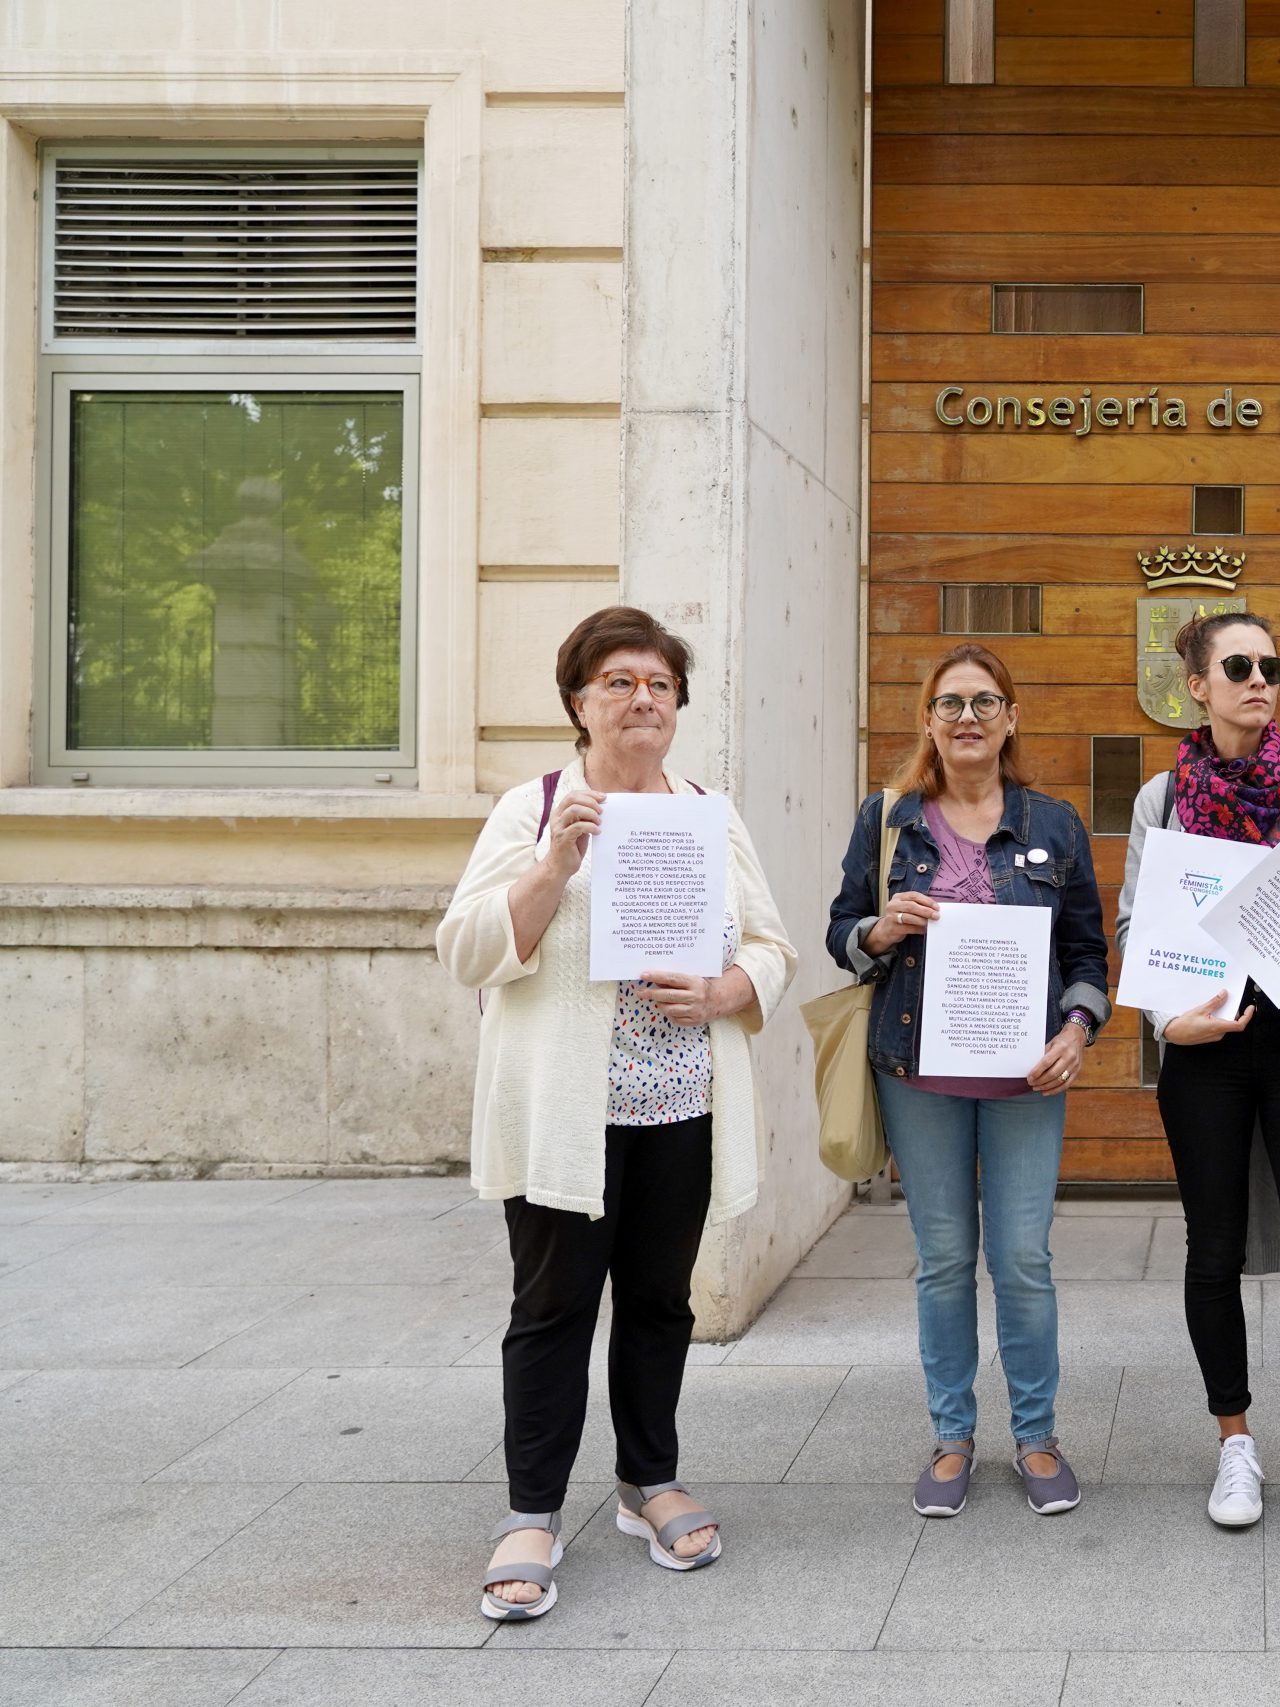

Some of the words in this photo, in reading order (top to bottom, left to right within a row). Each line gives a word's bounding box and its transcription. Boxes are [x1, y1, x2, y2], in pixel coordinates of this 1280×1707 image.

[935, 386, 1187, 437] Consejería
[1206, 388, 1262, 428] de
[1179, 878, 1224, 892] FEMINISTAS
[1150, 948, 1161, 957] LA
[1163, 950, 1182, 961] VOZ
[1183, 954, 1190, 962] Y
[1190, 955, 1200, 964] EL
[1201, 957, 1227, 968] VOTO
[1148, 959, 1161, 967] DE
[1162, 961, 1180, 971] LAS
[1182, 965, 1225, 979] MUJERES
